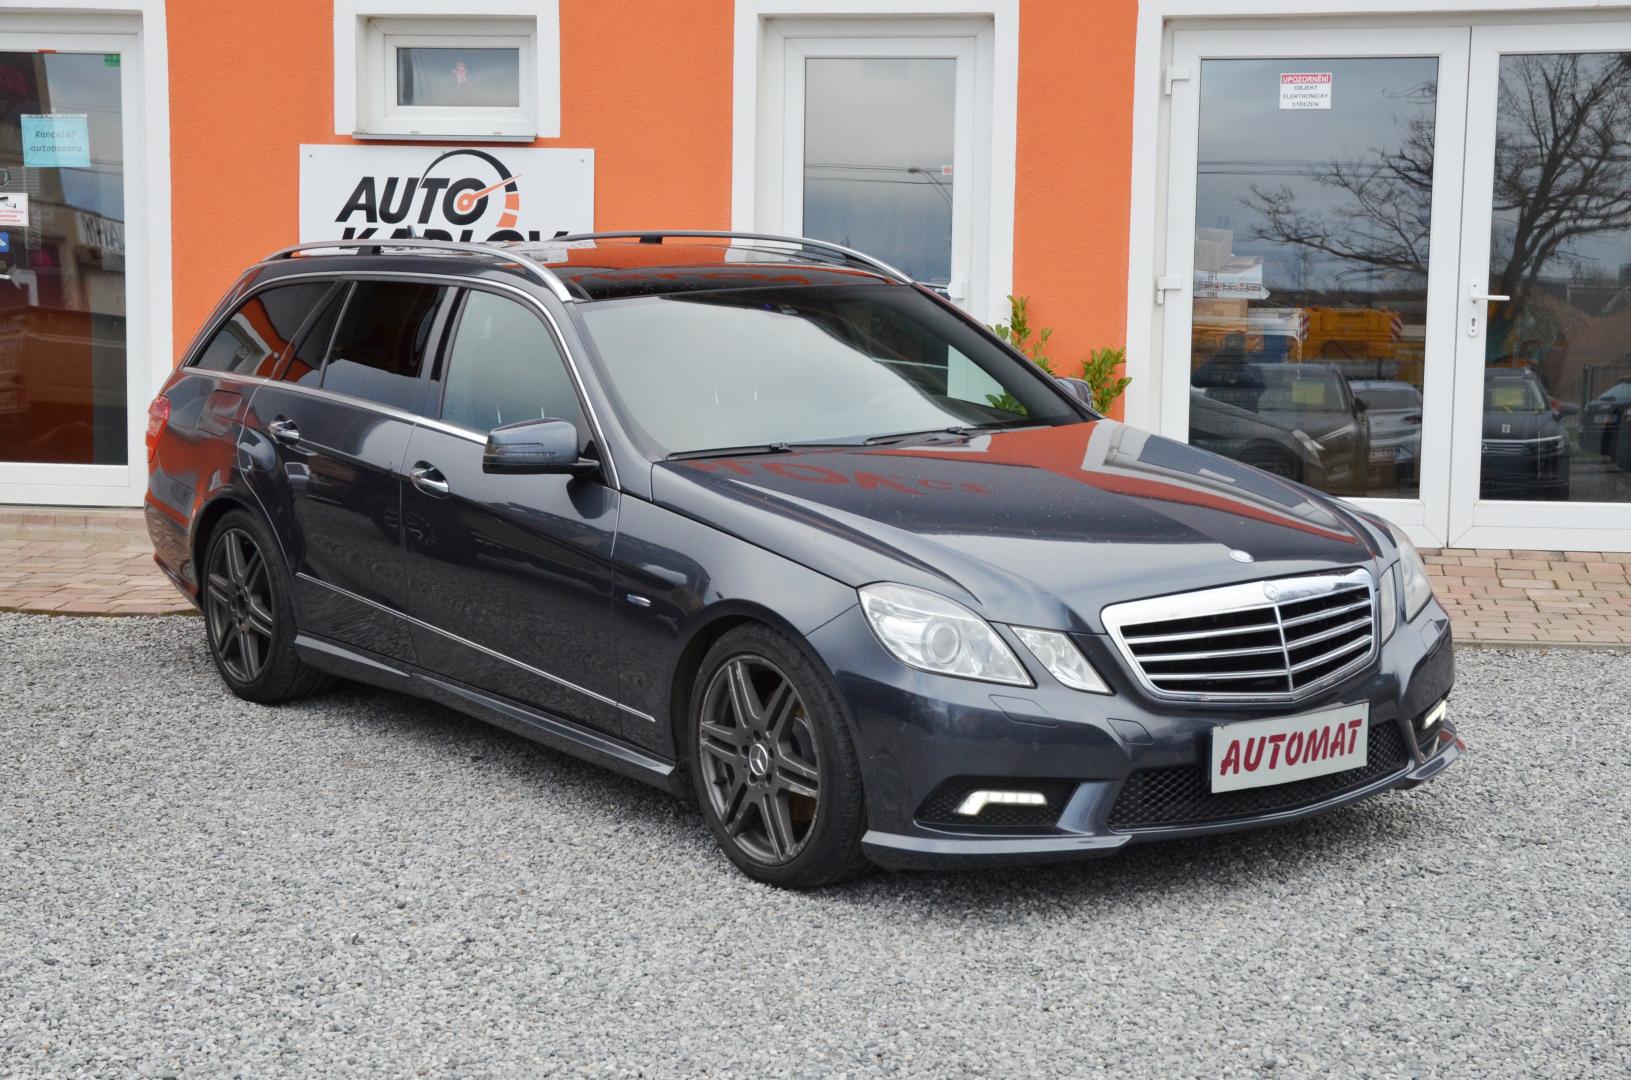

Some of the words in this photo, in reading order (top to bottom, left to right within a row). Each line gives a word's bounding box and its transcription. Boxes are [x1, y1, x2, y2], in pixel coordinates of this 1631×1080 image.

[30, 144, 82, 153] autobazaru
[335, 176, 489, 226] AUTO
[1220, 719, 1363, 776] AUTOMAT
